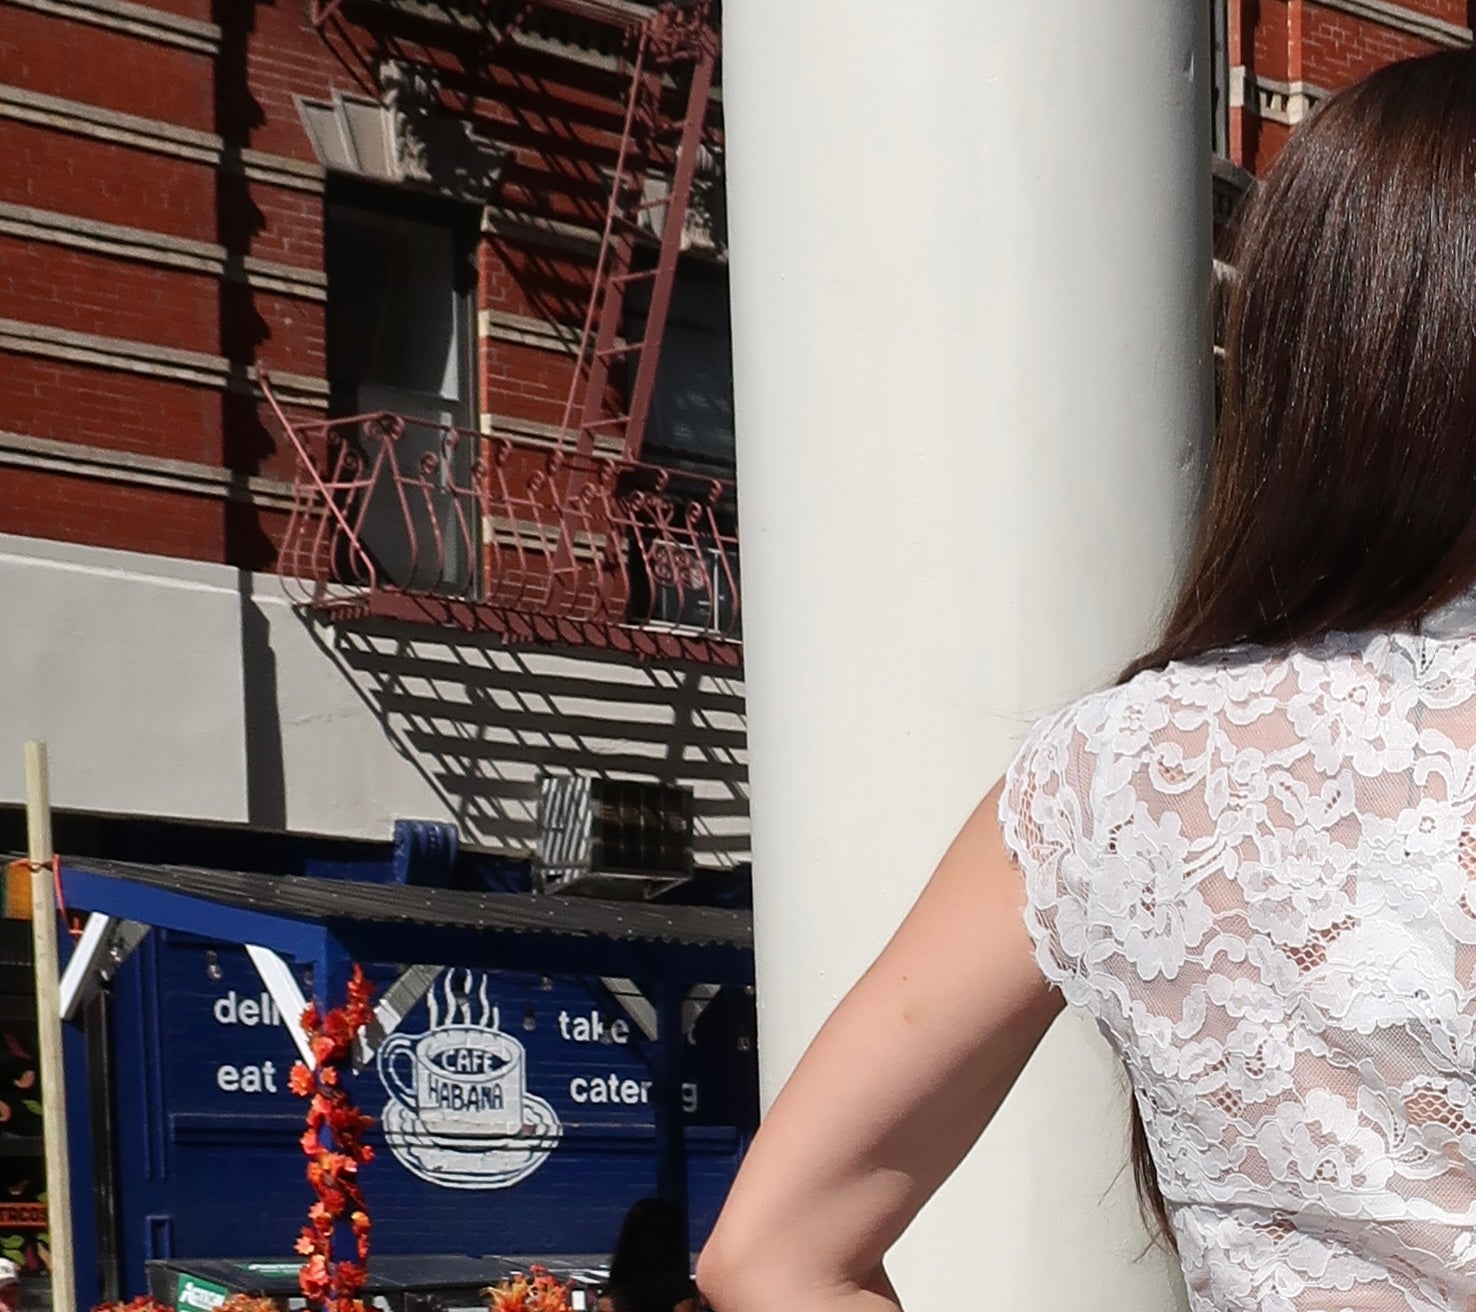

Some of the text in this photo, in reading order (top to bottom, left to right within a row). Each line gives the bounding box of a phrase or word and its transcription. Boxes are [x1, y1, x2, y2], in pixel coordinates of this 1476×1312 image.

[558, 1010, 630, 1044] take
[216, 1060, 277, 1093] eat
[428, 1071, 504, 1112] HABANA
[569, 1072, 697, 1112] caterg
